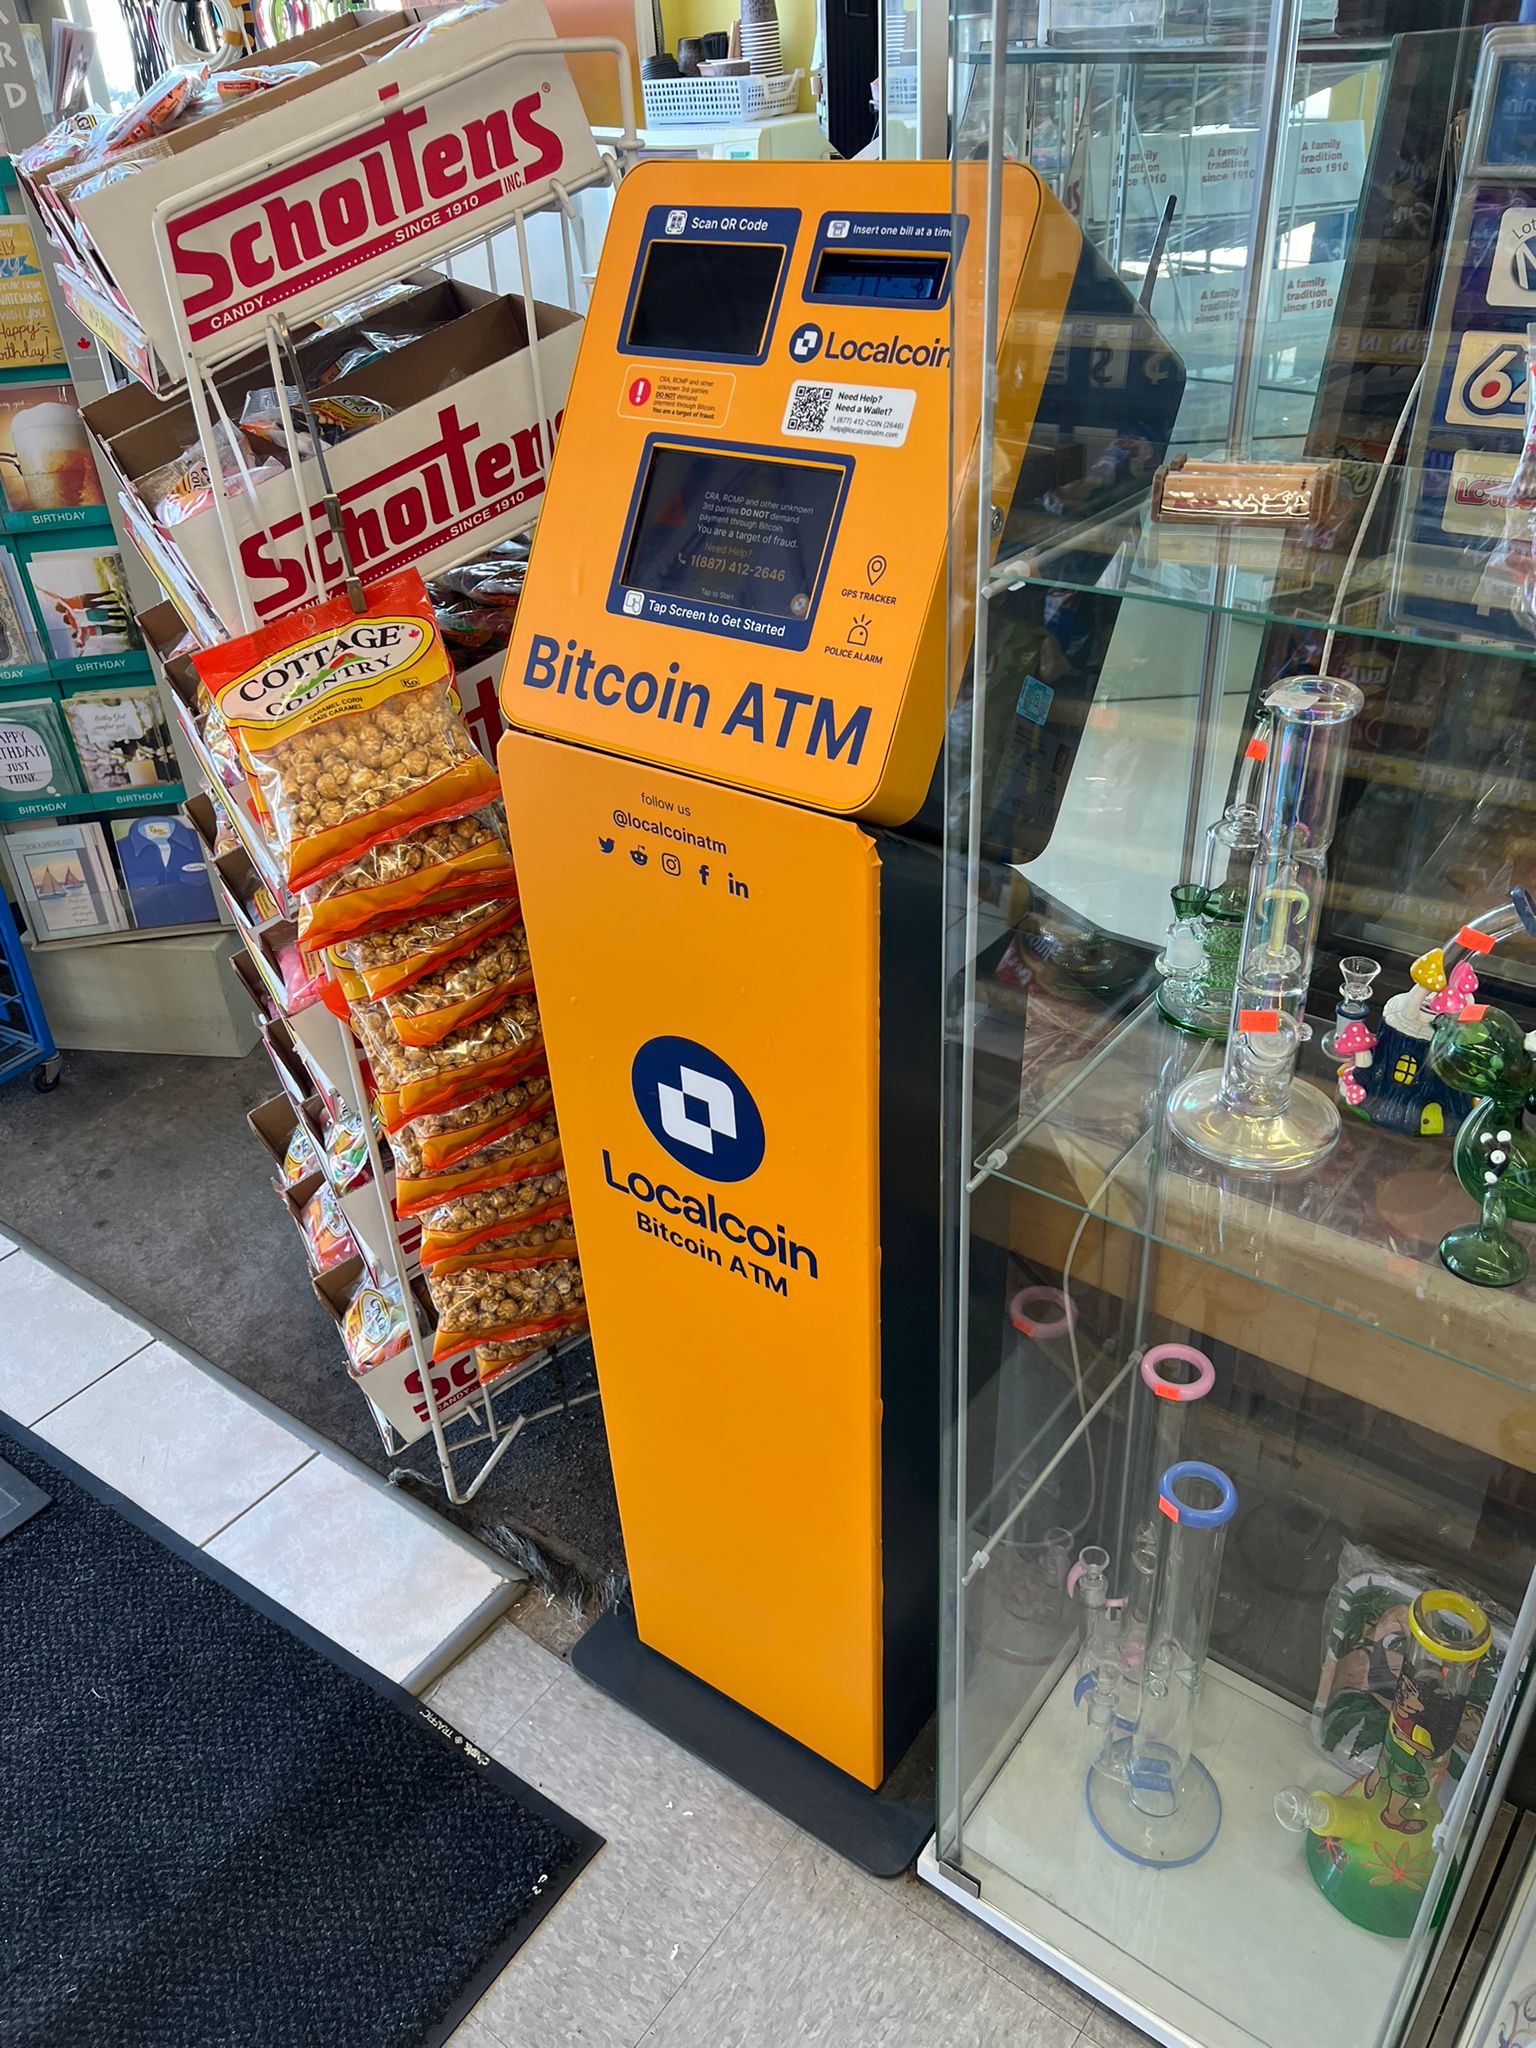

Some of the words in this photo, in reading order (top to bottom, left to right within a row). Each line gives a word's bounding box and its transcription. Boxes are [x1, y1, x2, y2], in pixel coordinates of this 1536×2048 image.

[1208, 148, 1216, 158] A
[1217, 146, 1248, 161] family
[1301, 141, 1309, 151] A
[1311, 139, 1342, 153] family
[1207, 158, 1250, 171] tradition
[1301, 151, 1343, 163] tradition
[1325, 162, 1349, 173] 1910
[1201, 172, 1229, 184] since
[167, 83, 564, 317] Scholtens
[395, 214, 442, 243] SINCE
[445, 195, 480, 220] 1910
[501, 171, 527, 197] INC.
[691, 216, 719, 231] Scan
[720, 217, 738, 232] QR
[739, 217, 769, 232] Code
[852, 224, 880, 235] Insert
[880, 226, 898, 236] one
[899, 225, 914, 236] bill
[914, 226, 925, 237] at
[926, 228, 934, 237] a
[1287, 279, 1295, 290] A
[1296, 276, 1327, 292] family
[1200, 291, 1209, 301] A
[1209, 287, 1240, 301] family
[1286, 288, 1328, 301] tradition
[1310, 298, 1334, 310] 1910
[1195, 313, 1220, 325] since
[824, 331, 952, 370] Localcoin
[664, 392, 676, 400] NOT
[838, 391, 859, 402] Need
[859, 393, 883, 405] Help?
[835, 402, 856, 413] Need
[856, 406, 862, 414] a
[864, 405, 893, 417] Wallet?
[829, 425, 899, 439] help@localcoinatm.com
[704, 490, 721, 502] CRA,
[722, 493, 745, 505] RCMP
[745, 498, 759, 507] and
[760, 498, 780, 510] other
[780, 503, 814, 515] unknown
[31, 511, 87, 525] BIRTHDAY
[450, 510, 492, 537] SINCE
[494, 490, 526, 514] 1910
[714, 503, 739, 515] parties
[740, 507, 752, 516] DO
[753, 510, 769, 519] NOT
[770, 513, 801, 524] demand
[730, 516, 758, 530] through
[696, 523, 712, 535] You
[713, 527, 727, 537] are
[728, 530, 734, 538] a
[735, 530, 760, 543] target
[762, 535, 772, 544] of
[773, 536, 798, 549] fraud.
[704, 542, 727, 554] Need
[728, 545, 753, 558] Help?
[728, 561, 786, 582] 412-2646
[841, 588, 859, 600] GPS
[859, 591, 898, 606] TRACKER
[648, 599, 668, 617] Tap
[668, 603, 707, 623] Screen
[707, 610, 720, 625] to
[720, 613, 742, 630] Get
[743, 617, 787, 639] Started
[823, 645, 853, 660] POLICE
[852, 651, 884, 665] ALARM
[75, 658, 127, 673] BIRTHDAY
[238, 624, 402, 703] COTTAGE
[265, 653, 393, 718] COUNTRY
[341, 696, 364, 705] CORN
[523, 632, 712, 730] Bitcoin
[720, 681, 873, 767] ATM
[328, 704, 365, 716] CARAMEL
[0, 745, 47, 760] THDAY!
[7, 761, 30, 773] JUST
[115, 791, 165, 804] BIRTHDAY
[640, 792, 676, 815] follow
[677, 804, 692, 817] us
[18, 802, 68, 815] BIRTHDAY
[612, 809, 728, 855] @localcoinatm
[602, 1148, 819, 1280] Localcoin
[636, 1210, 723, 1267] Bitcoin
[728, 1255, 788, 1298] ATM
